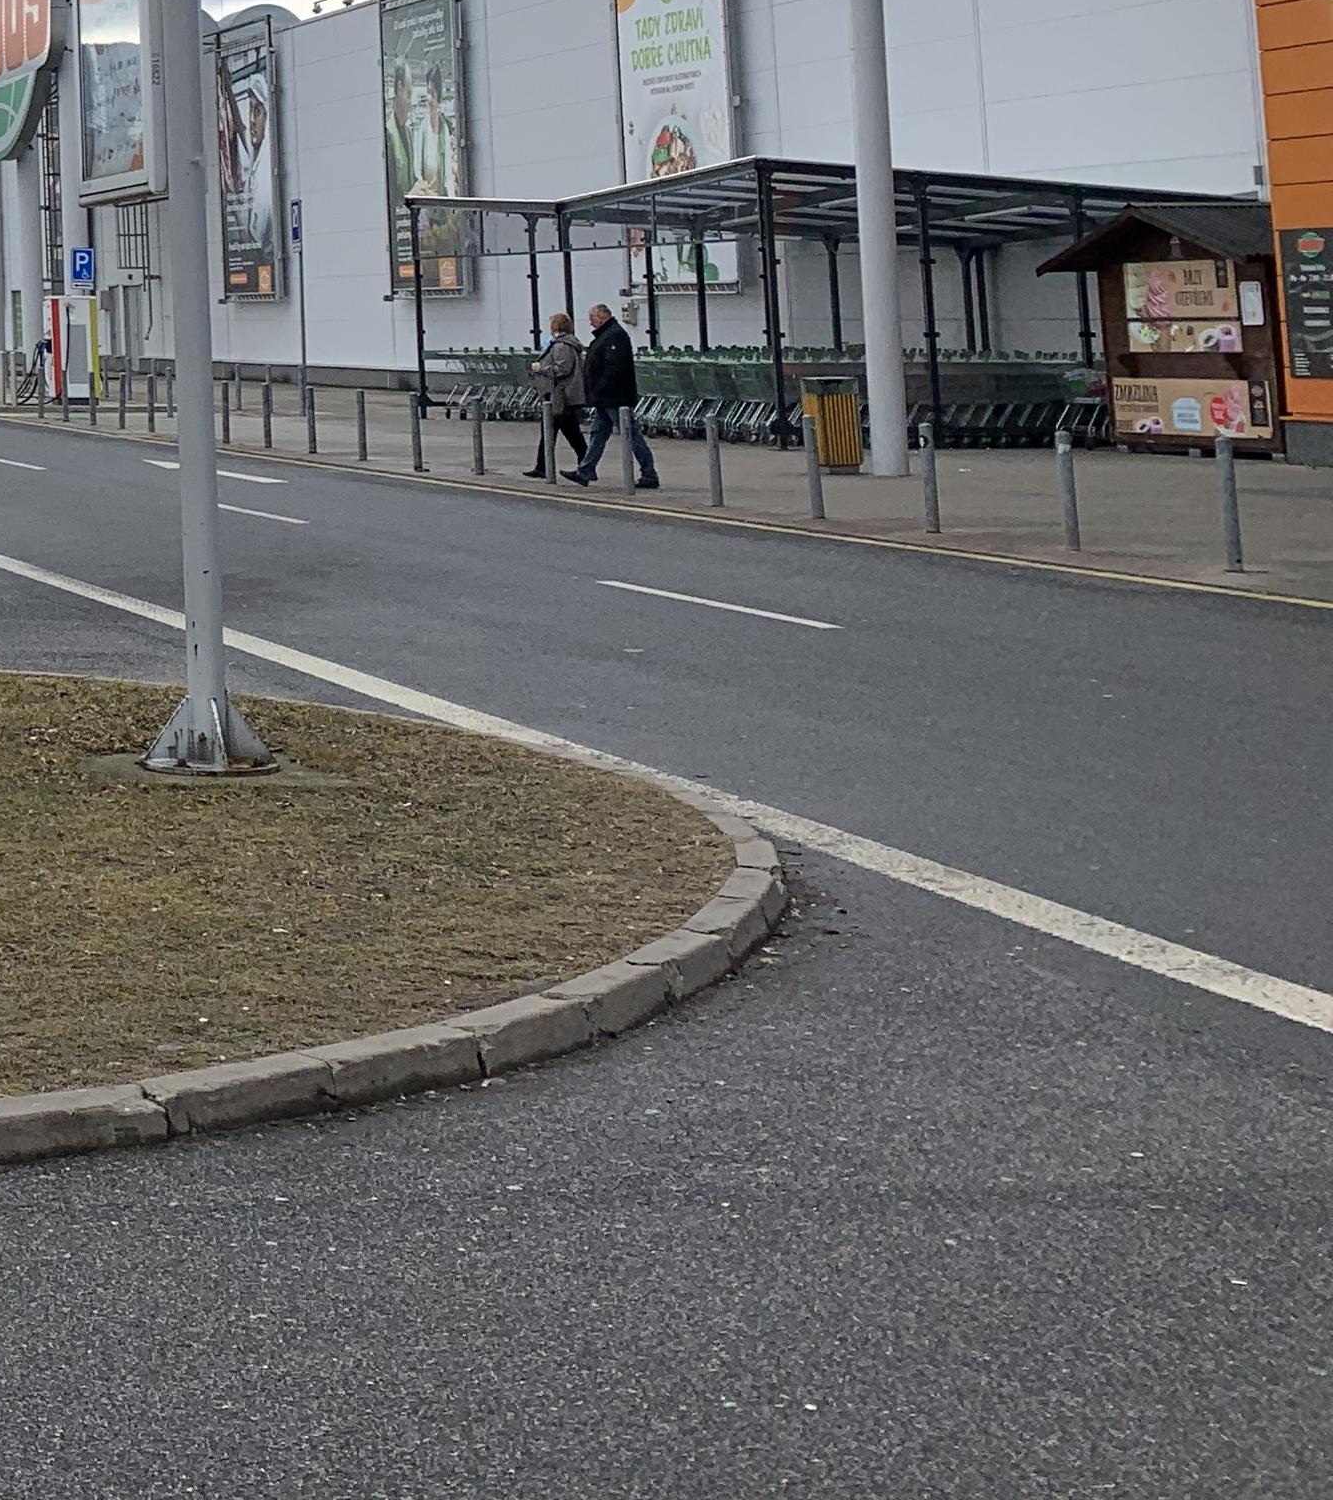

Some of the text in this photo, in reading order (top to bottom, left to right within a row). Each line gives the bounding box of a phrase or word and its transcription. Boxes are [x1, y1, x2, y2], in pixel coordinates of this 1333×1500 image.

[635, 2, 704, 41] TADY ZDRAVÍ
[631, 30, 713, 73] DOBŘE CHUTNÁ
[76, 252, 89, 271] P
